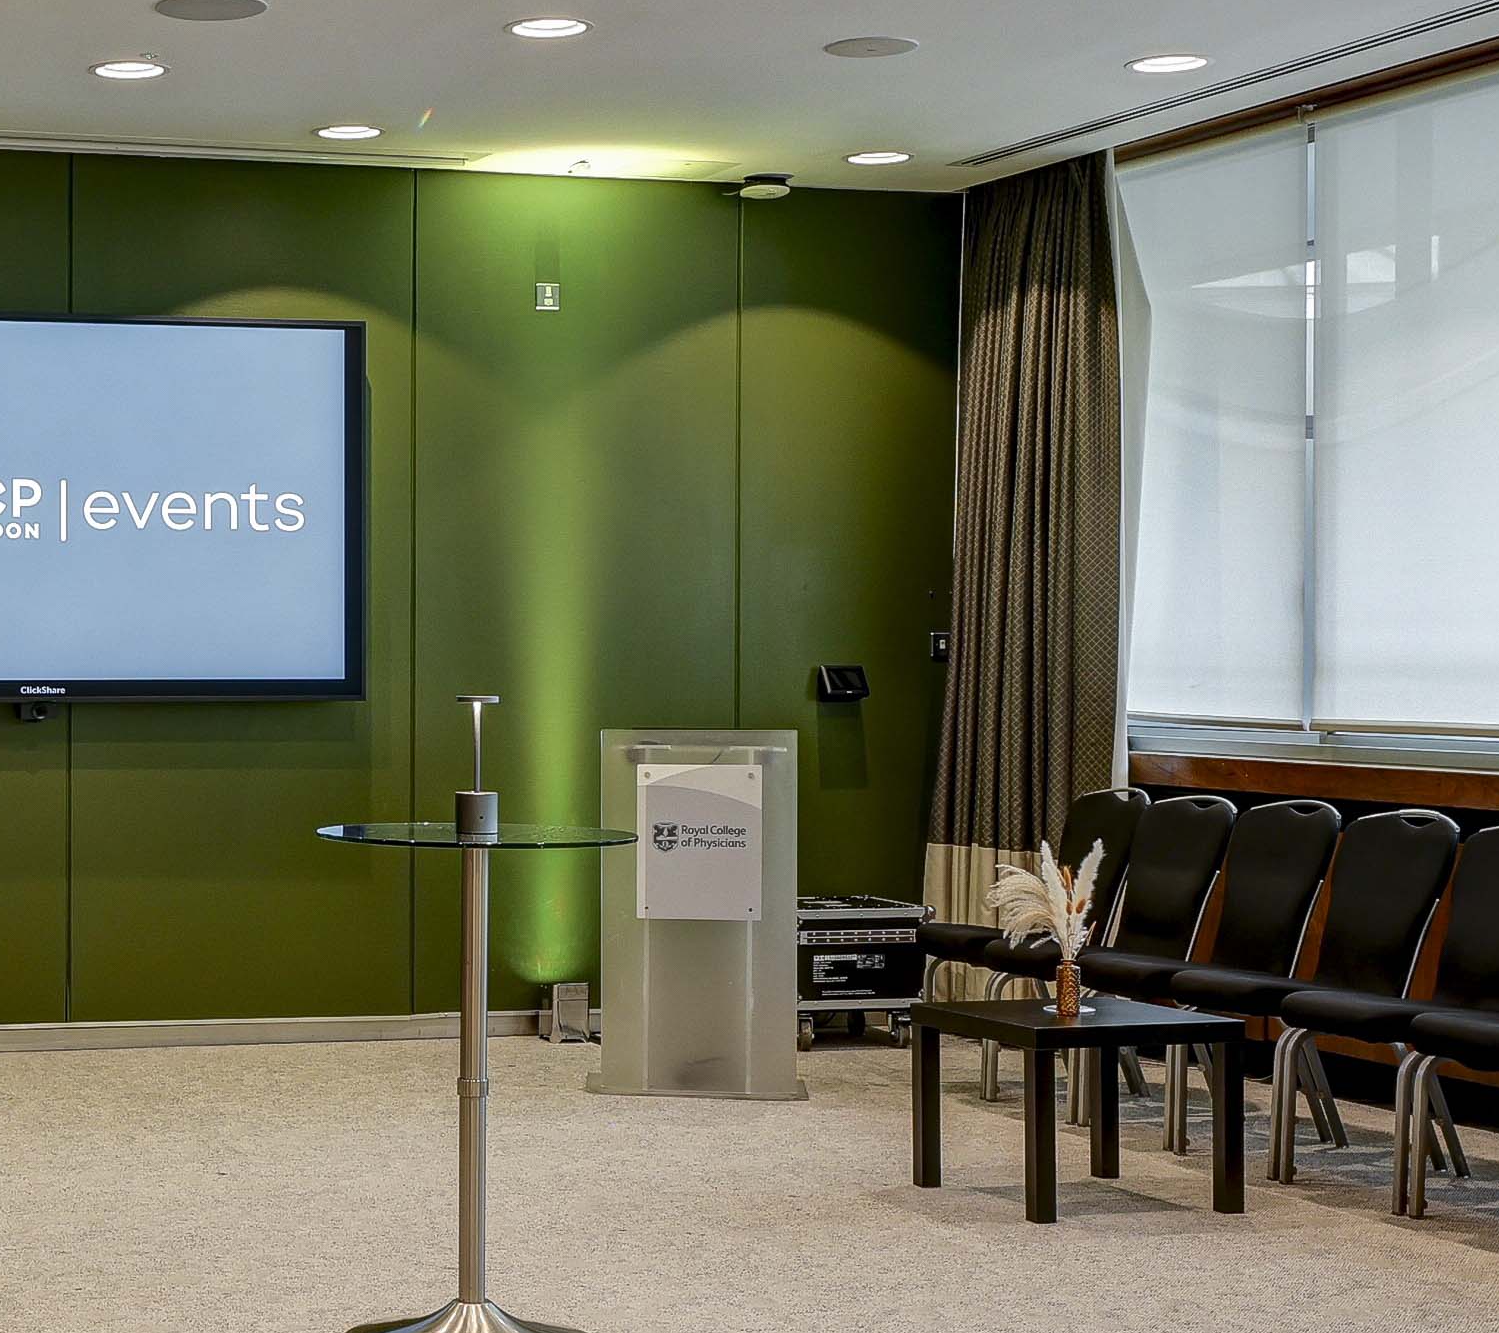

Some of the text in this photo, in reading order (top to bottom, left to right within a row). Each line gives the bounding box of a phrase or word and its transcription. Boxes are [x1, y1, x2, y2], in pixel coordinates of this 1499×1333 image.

[83, 483, 306, 533] events
[20, 685, 66, 695] ClickShare
[681, 825, 747, 837] Royal College
[681, 837, 747, 849] of Physicians
